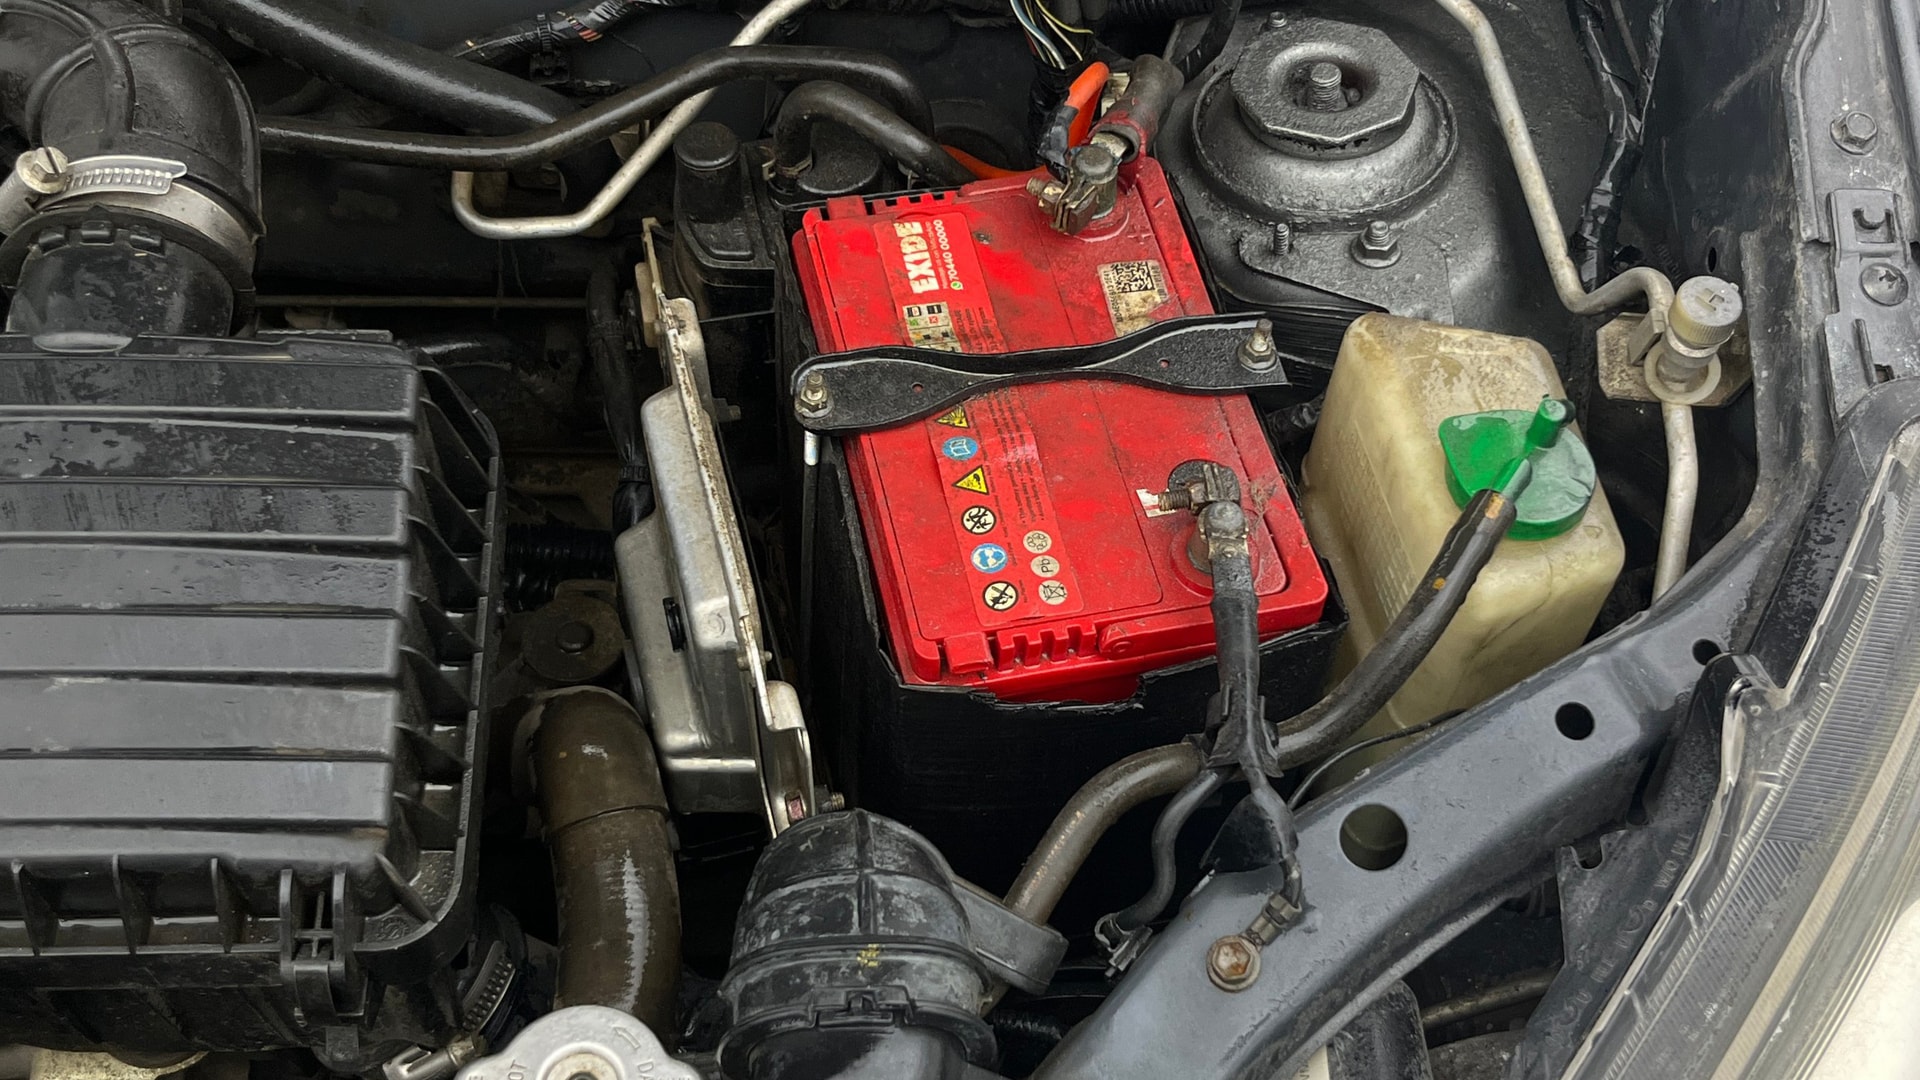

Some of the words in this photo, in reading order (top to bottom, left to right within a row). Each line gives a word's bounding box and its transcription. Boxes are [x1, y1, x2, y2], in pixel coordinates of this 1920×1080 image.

[933, 219, 950, 250] 00000
[893, 222, 939, 293] EXIDE
[942, 252, 959, 281] 70440
[1041, 558, 1053, 573] Pb
